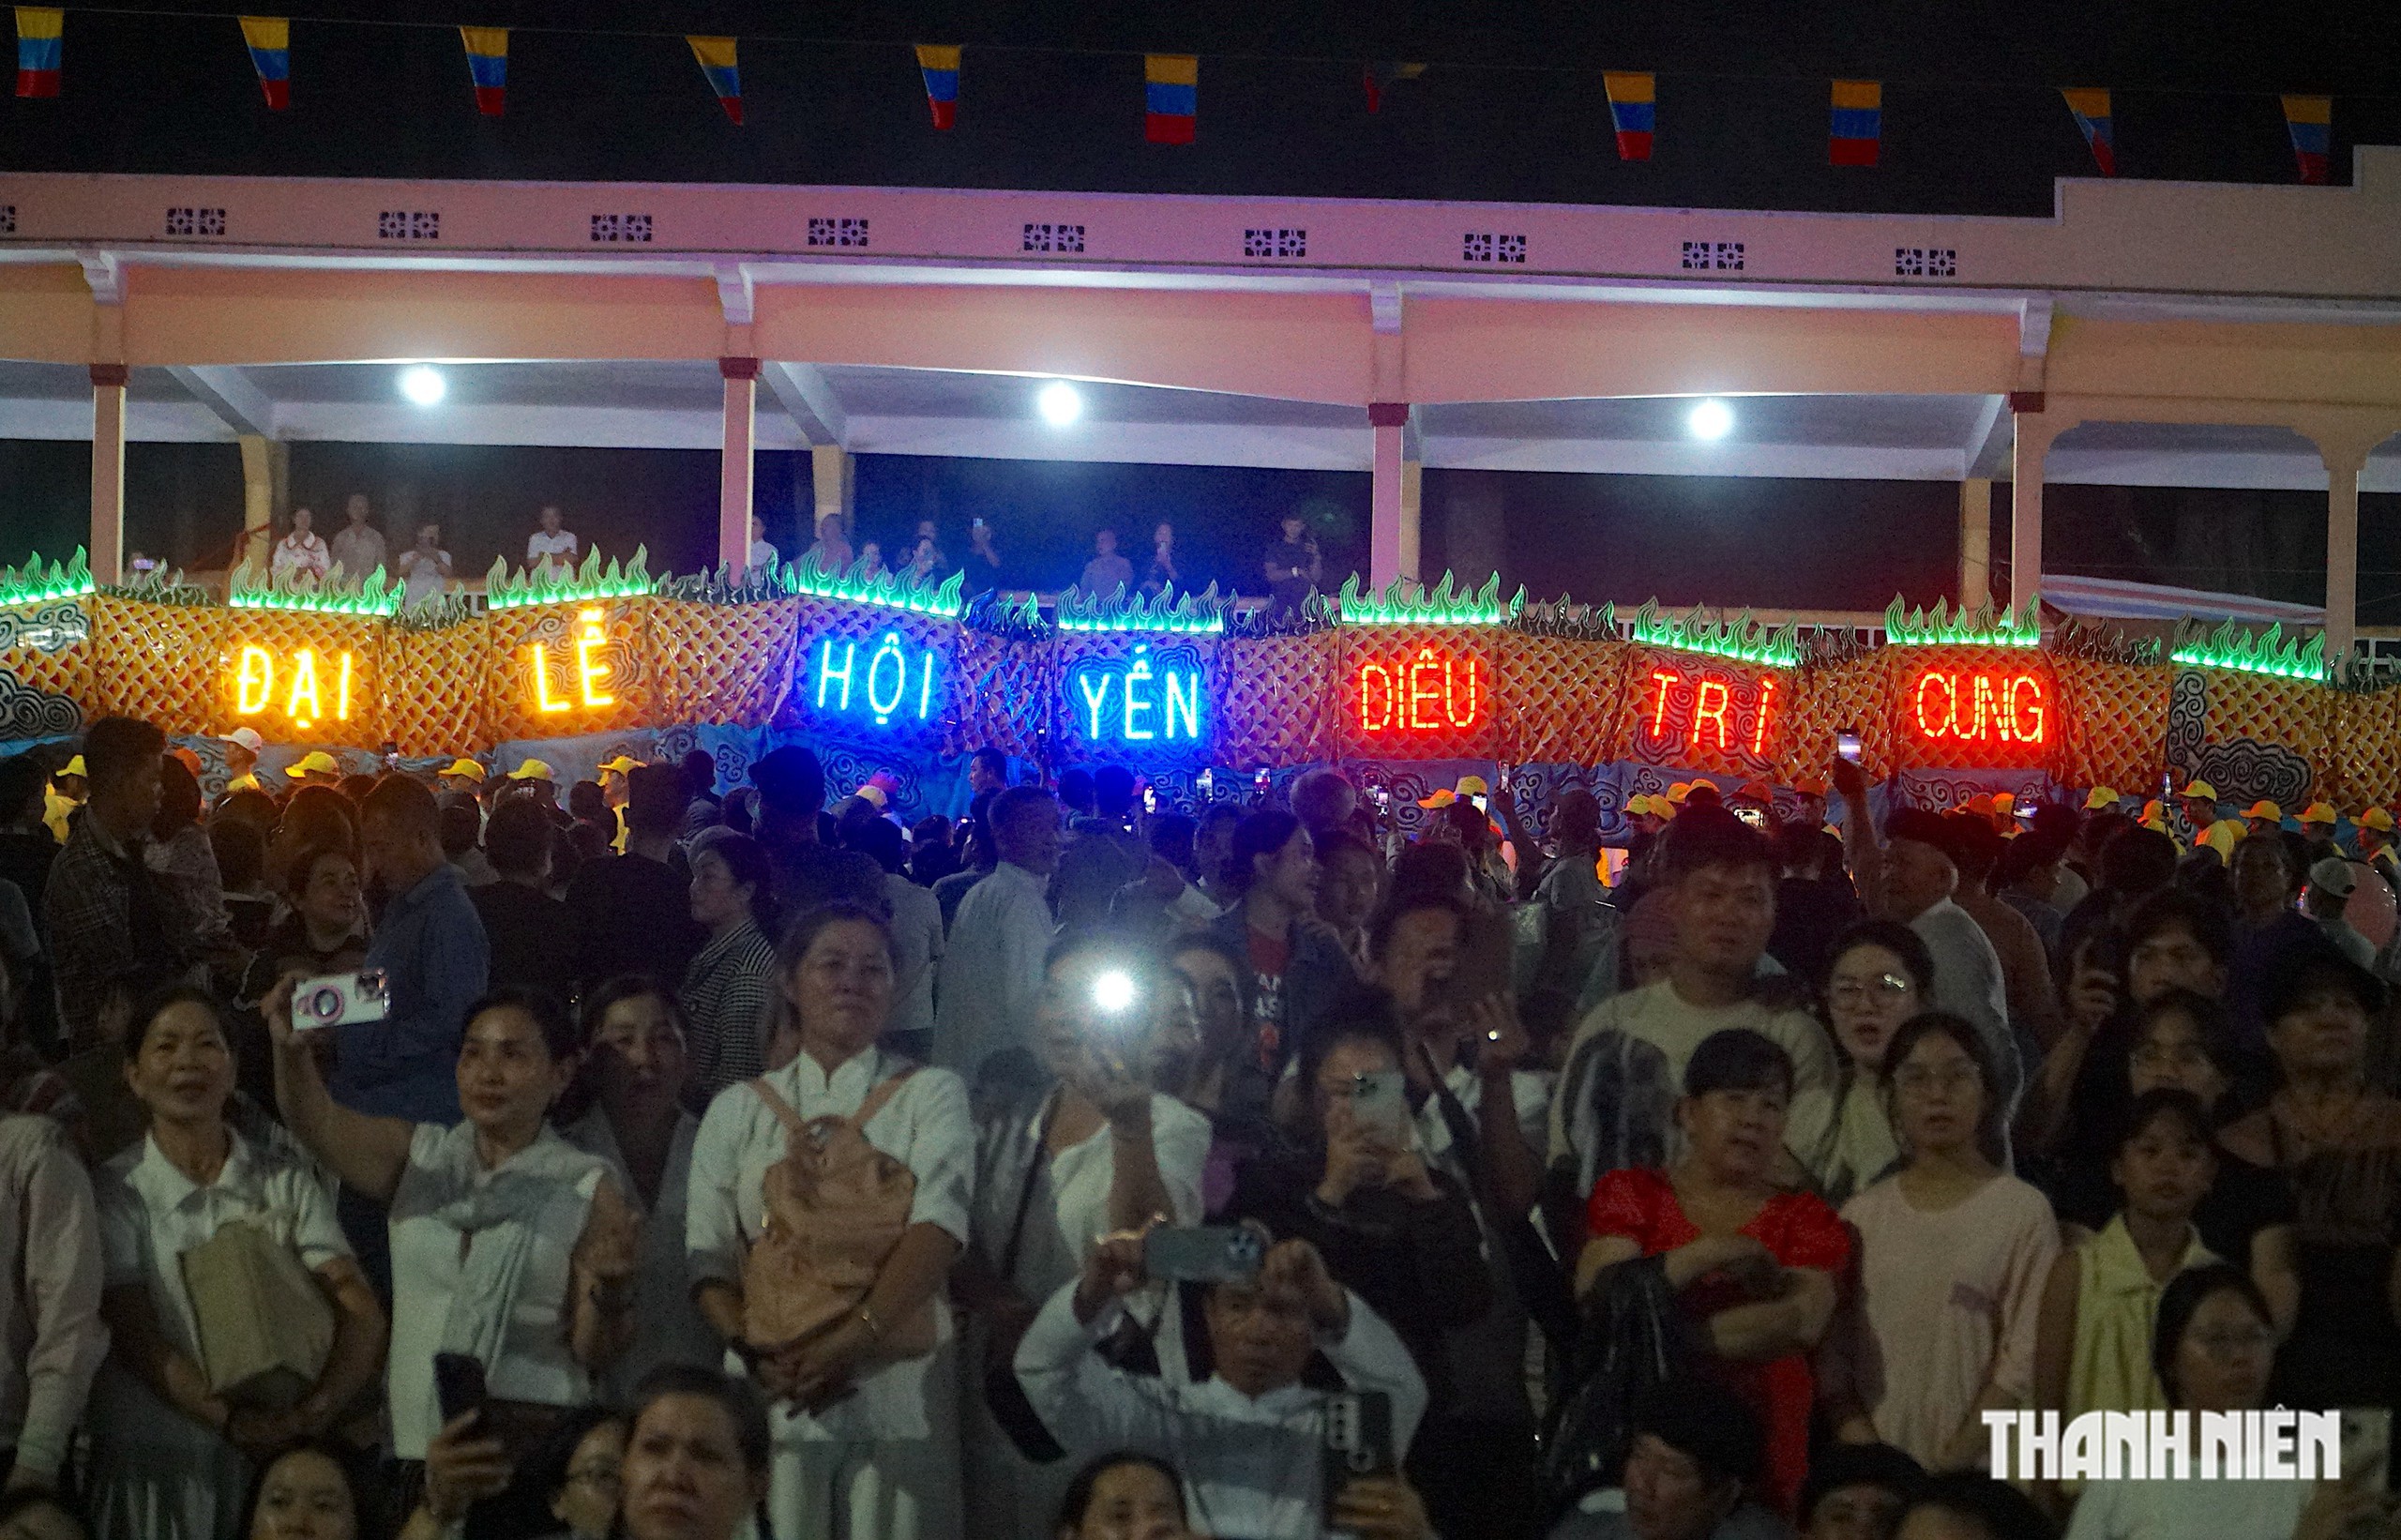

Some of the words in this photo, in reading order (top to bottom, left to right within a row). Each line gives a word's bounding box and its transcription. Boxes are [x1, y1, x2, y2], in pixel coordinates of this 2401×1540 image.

[235, 645, 353, 730] ĐẠI
[533, 607, 614, 713] LỄ
[817, 631, 934, 725] HỘI
[1079, 644, 1200, 740] YẾN
[1653, 672, 1774, 754] TRÌ
[1916, 672, 2044, 744] CUNG
